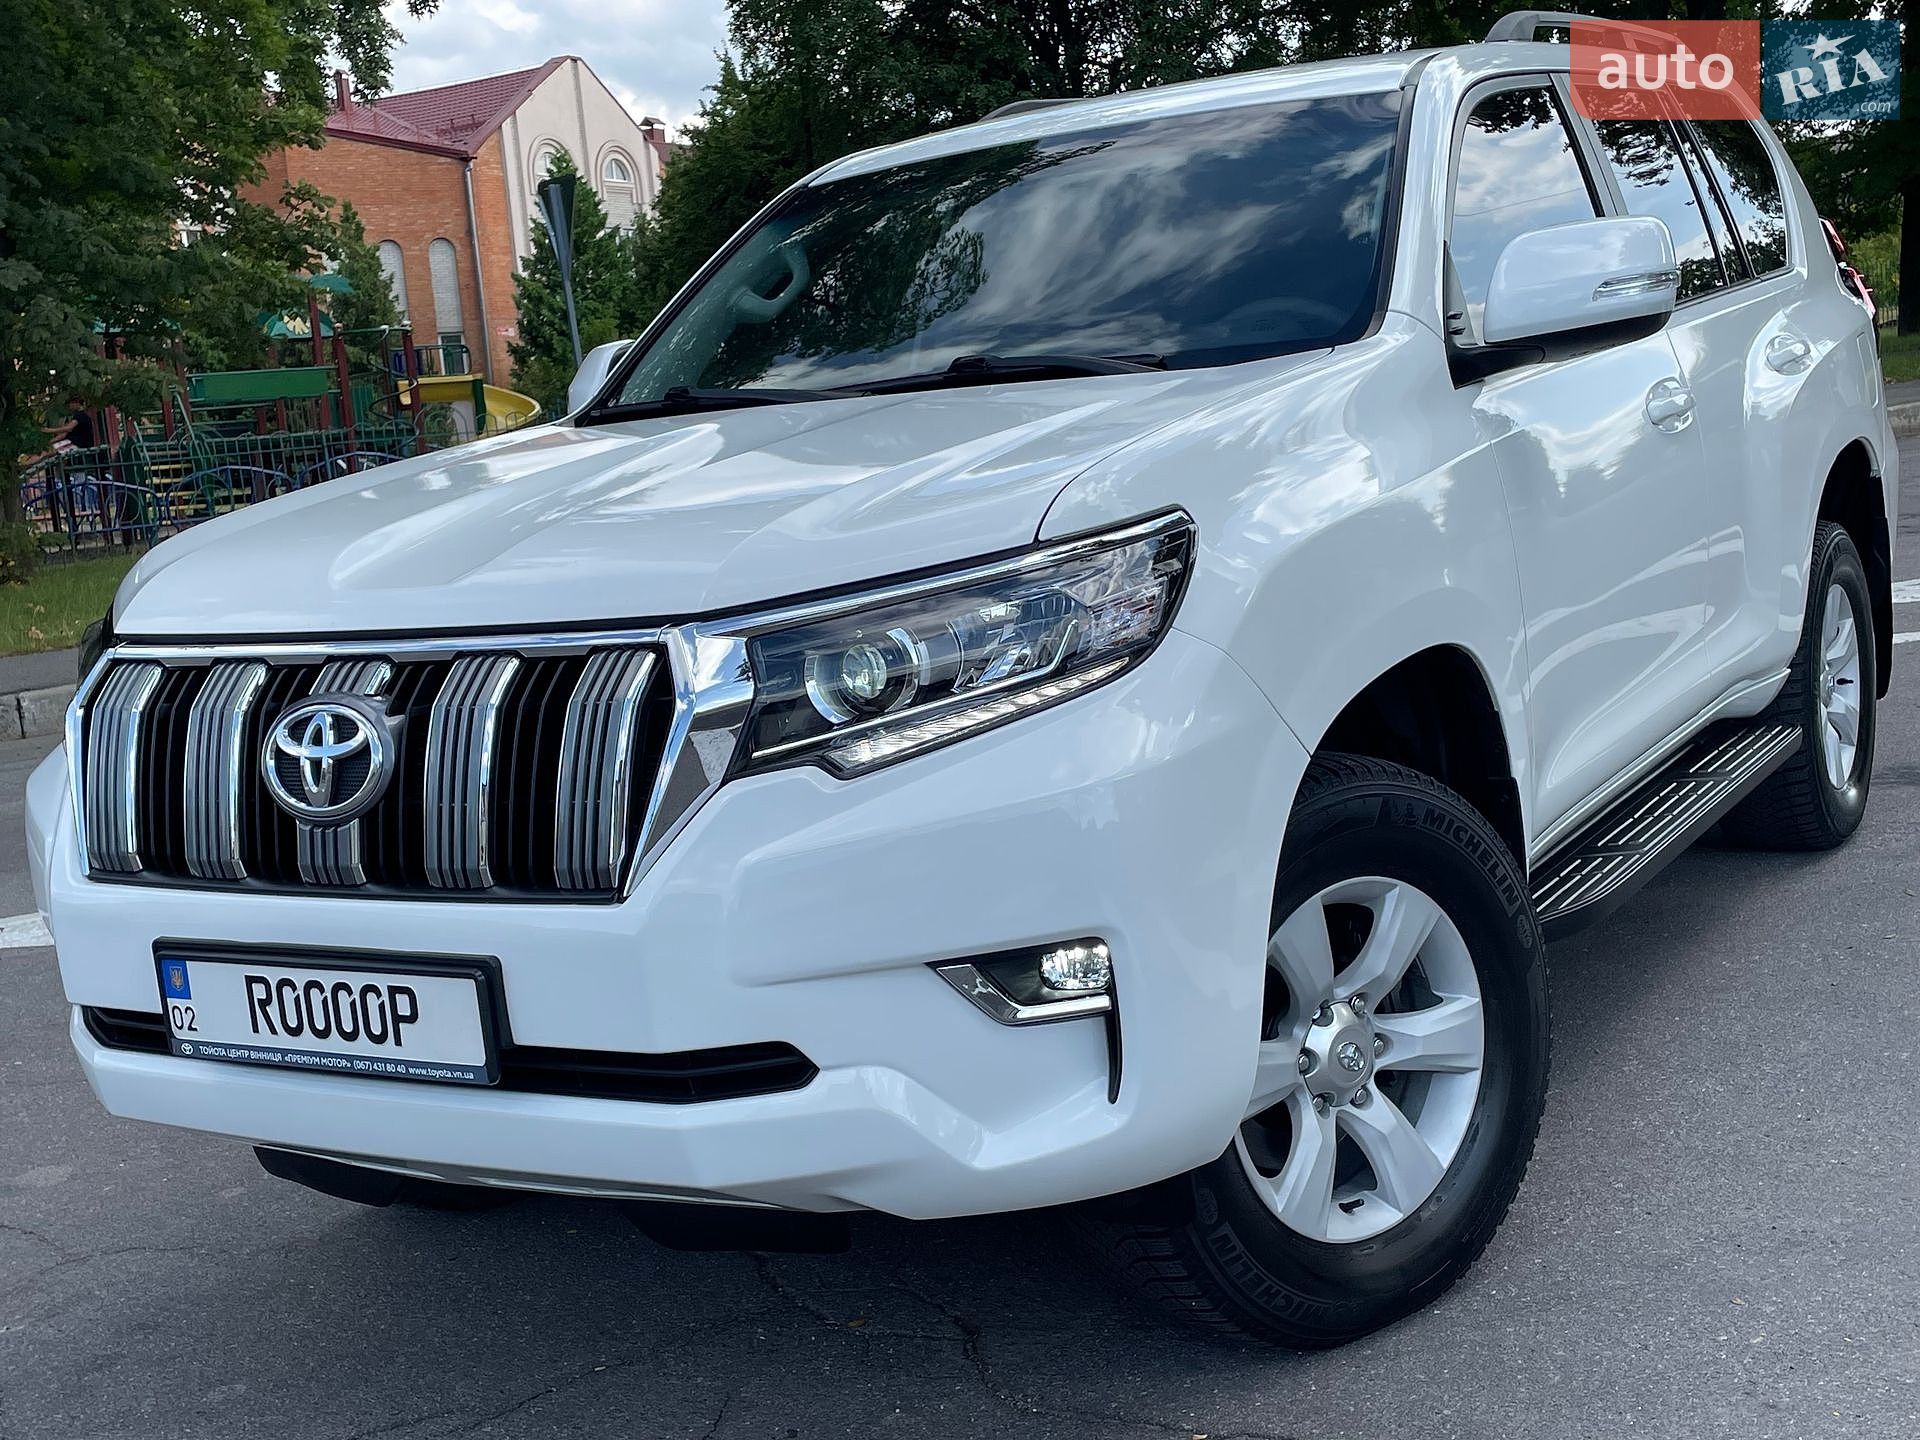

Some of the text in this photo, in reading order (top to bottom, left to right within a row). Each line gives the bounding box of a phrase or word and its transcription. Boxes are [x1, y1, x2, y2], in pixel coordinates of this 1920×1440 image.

[1422, 806, 1520, 906] MICHELIN
[172, 1005, 198, 1031] 02
[199, 1045, 227, 1056] ТОЙОТА
[227, 1048, 250, 1059] ЦЕНТР
[353, 1061, 372, 1071] (067)
[373, 1062, 385, 1072] 431
[386, 1064, 396, 1072] 80
[397, 1065, 406, 1073] 40
[408, 1067, 474, 1079] www.toyota.vn.ua
